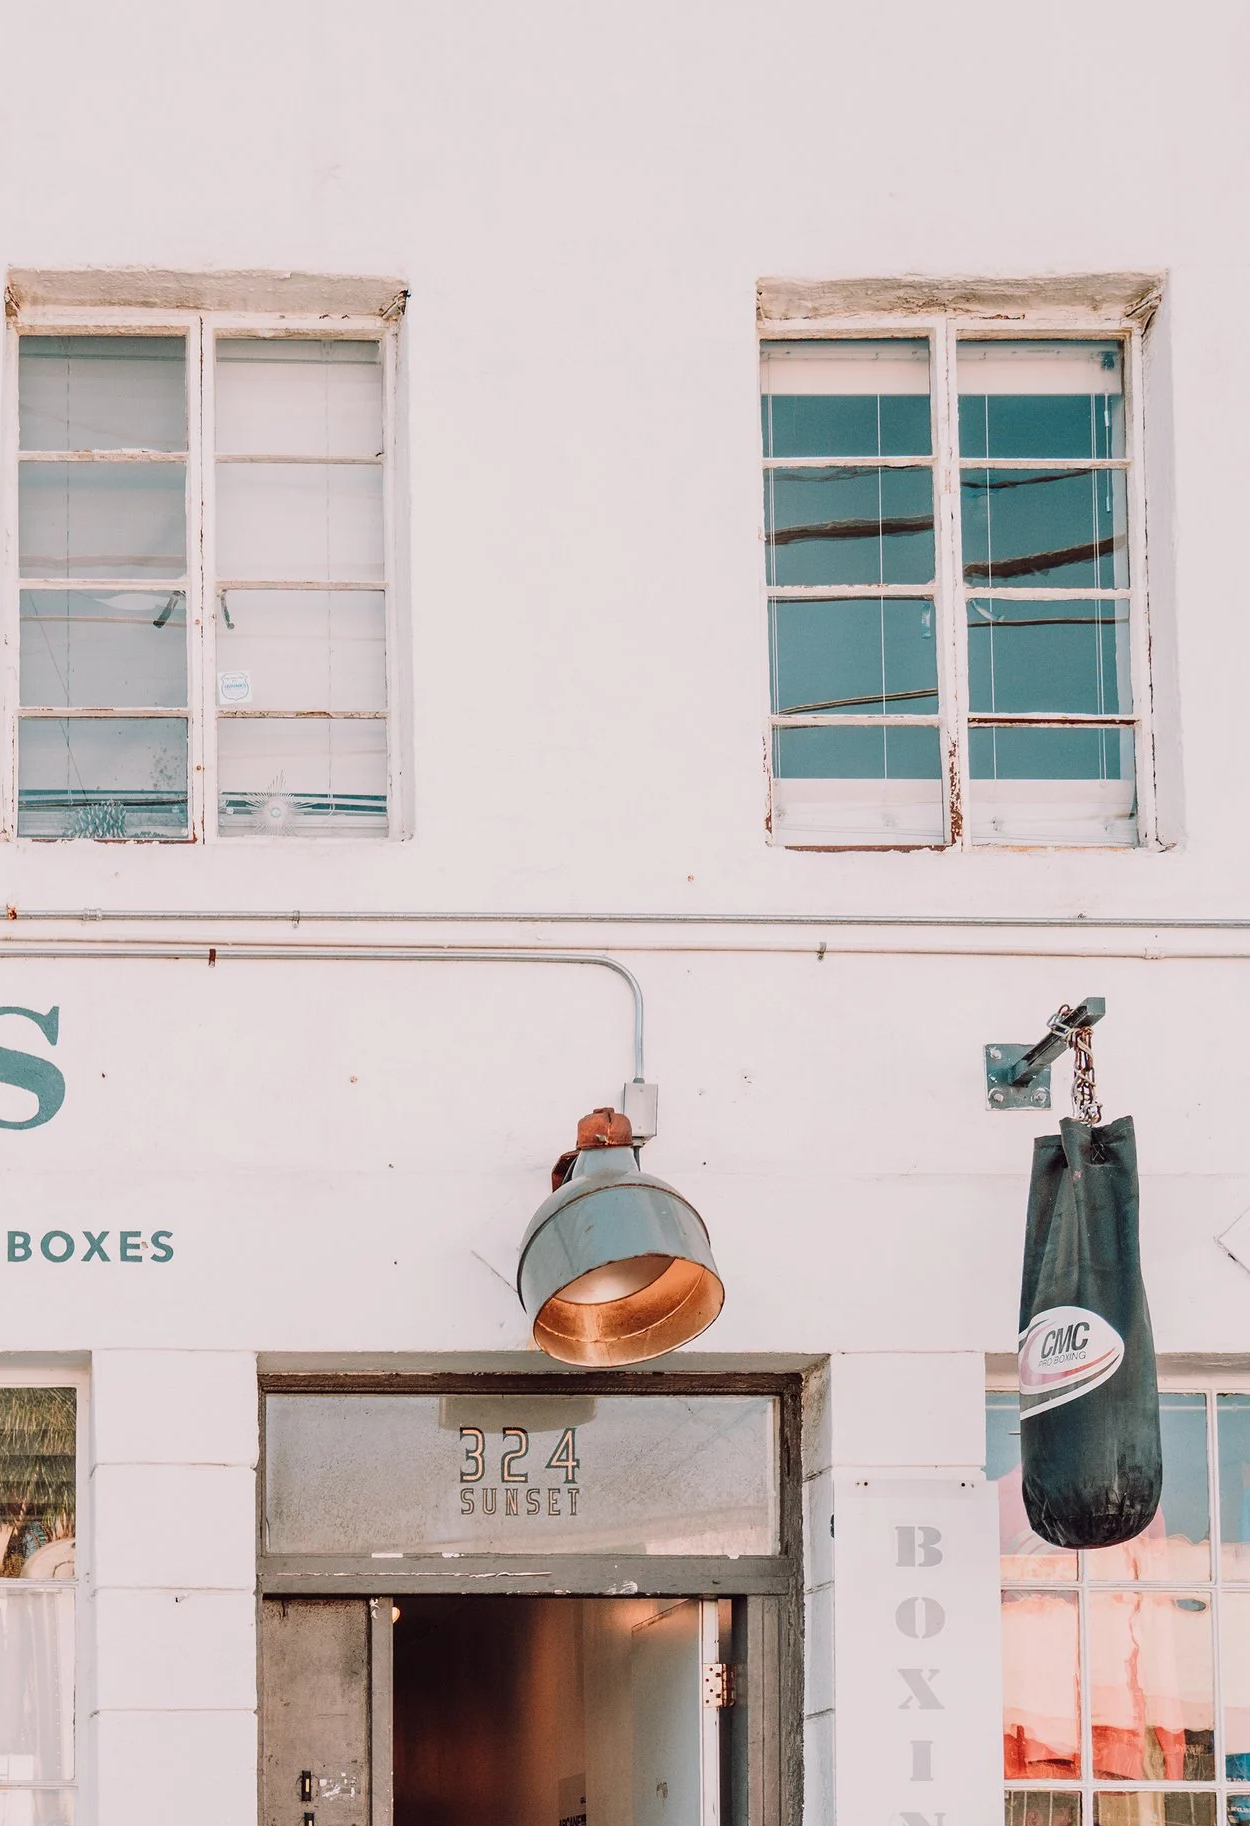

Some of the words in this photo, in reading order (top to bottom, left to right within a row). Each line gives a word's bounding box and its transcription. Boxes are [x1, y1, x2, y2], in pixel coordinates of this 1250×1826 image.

[7, 1230, 175, 1263] BOXES
[1041, 1322, 1090, 1359] CMC
[1038, 1358, 1052, 1368] PRO
[1053, 1351, 1087, 1364] BOXING
[459, 1427, 580, 1484] 324
[460, 1488, 580, 1516] SUNSET
